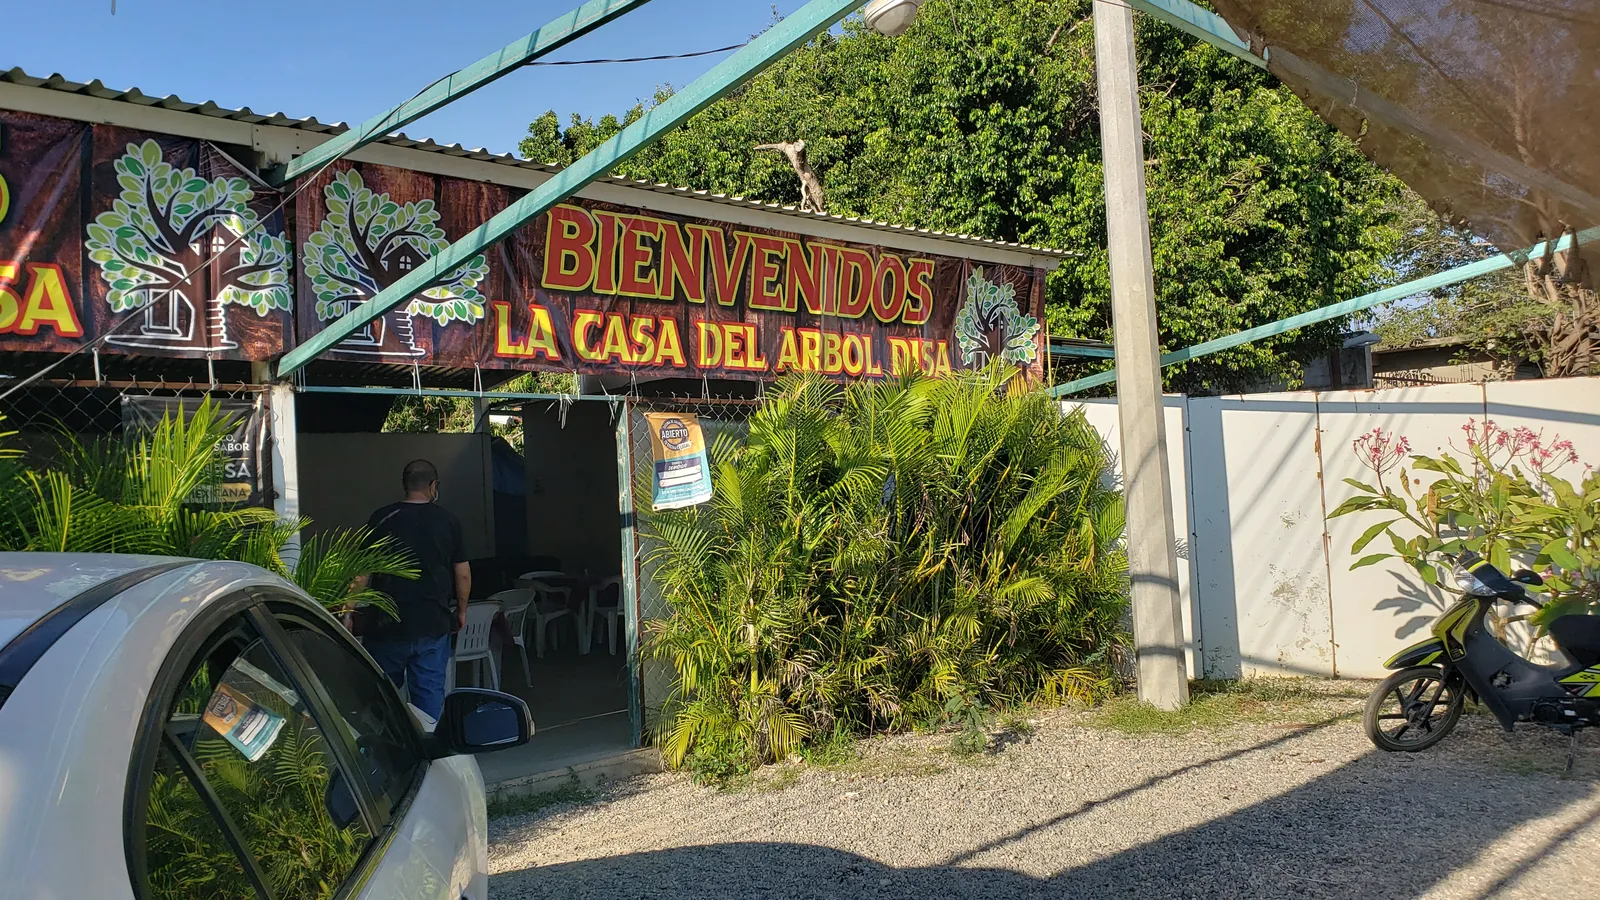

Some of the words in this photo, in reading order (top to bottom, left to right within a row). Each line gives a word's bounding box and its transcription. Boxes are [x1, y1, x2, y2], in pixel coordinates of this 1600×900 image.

[541, 203, 935, 325] BIENVENIDOS
[492, 301, 562, 361] LA
[570, 308, 688, 368] CASA
[694, 319, 769, 371] DEL
[776, 325, 884, 377] ARBOL
[887, 335, 953, 379] DISA
[214, 442, 250, 452] SABOR
[661, 429, 688, 439] ABIERTO
